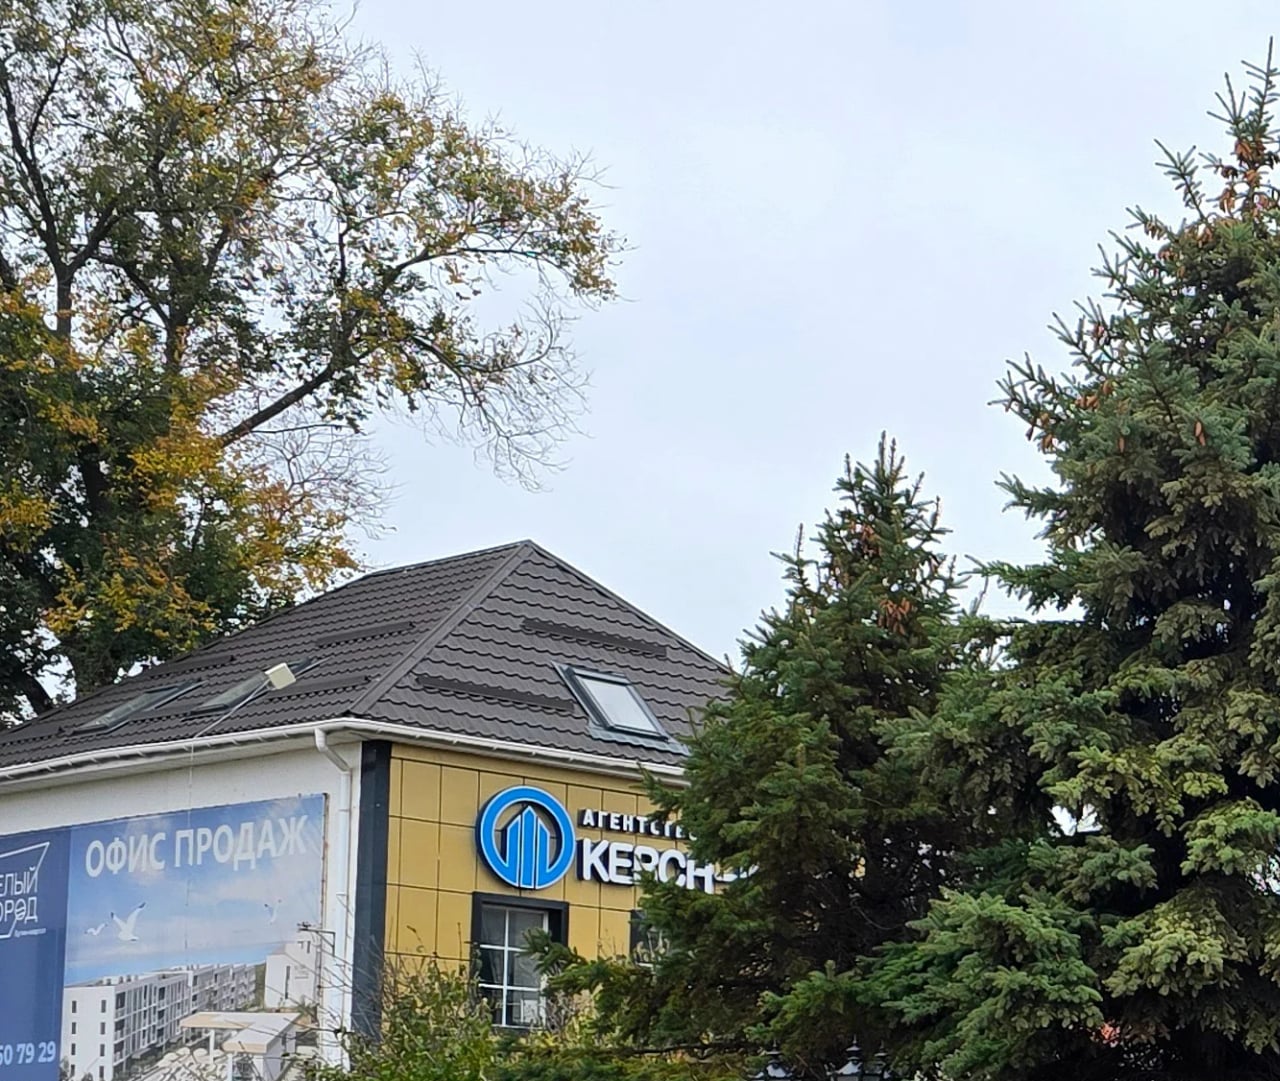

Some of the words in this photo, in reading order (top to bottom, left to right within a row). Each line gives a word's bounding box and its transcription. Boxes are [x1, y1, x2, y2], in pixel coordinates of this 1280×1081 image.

[85, 832, 166, 878] ОФИС
[174, 815, 308, 871] ПРОДАЖ
[16, 1043, 35, 1065] 79
[38, 1041, 56, 1063] 29
